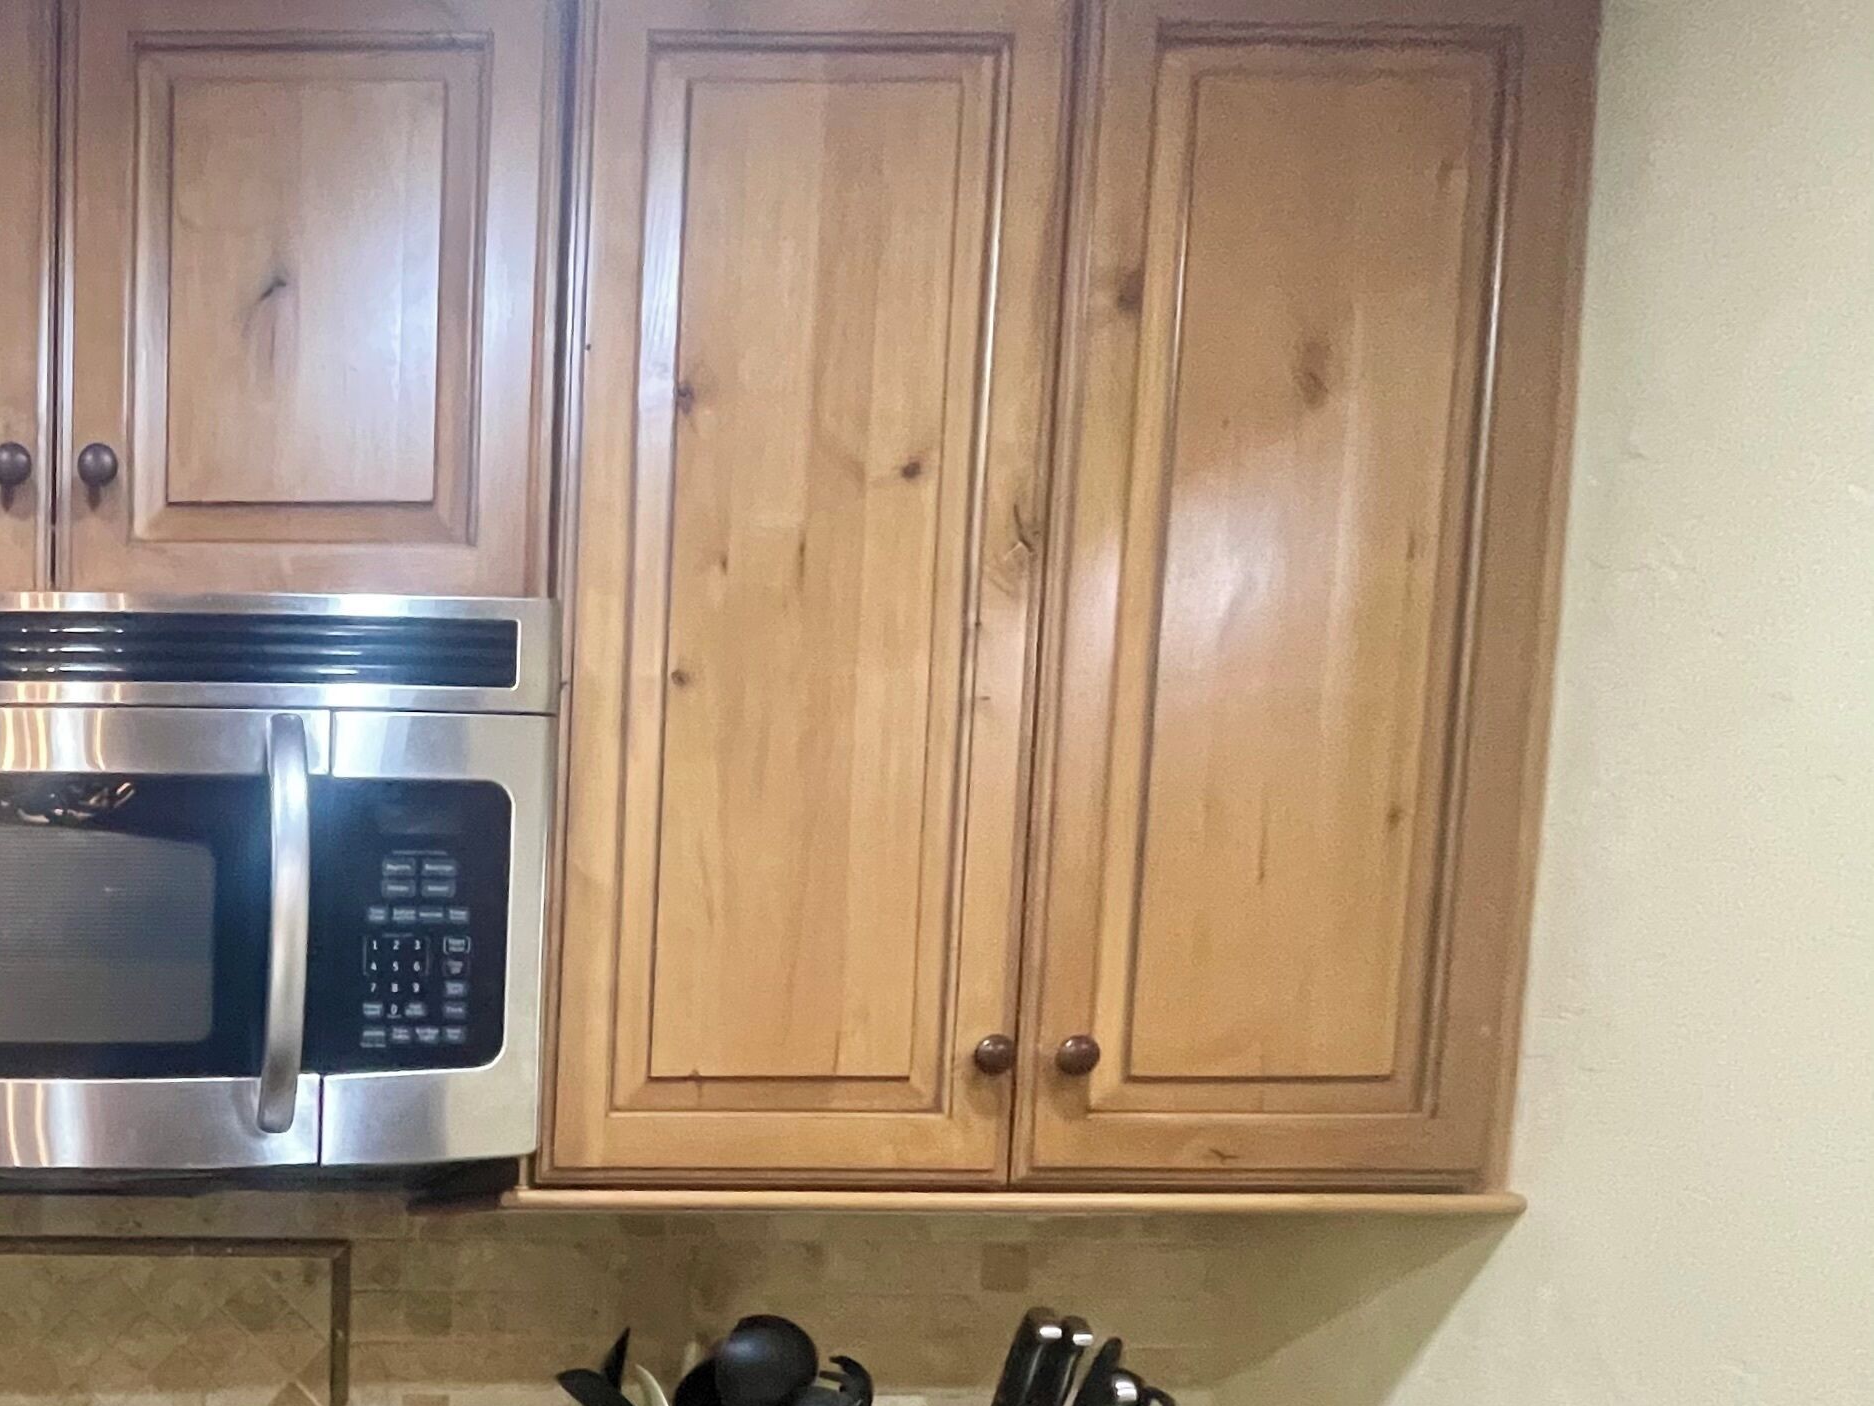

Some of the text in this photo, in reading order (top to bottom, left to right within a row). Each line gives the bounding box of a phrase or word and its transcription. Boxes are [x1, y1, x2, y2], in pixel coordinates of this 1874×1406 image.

[372, 939, 421, 951] 1 2 3
[392, 960, 399, 972] 5
[413, 960, 421, 972] 6
[370, 982, 420, 993] 7 8 9
[390, 1003, 398, 1015] 0
